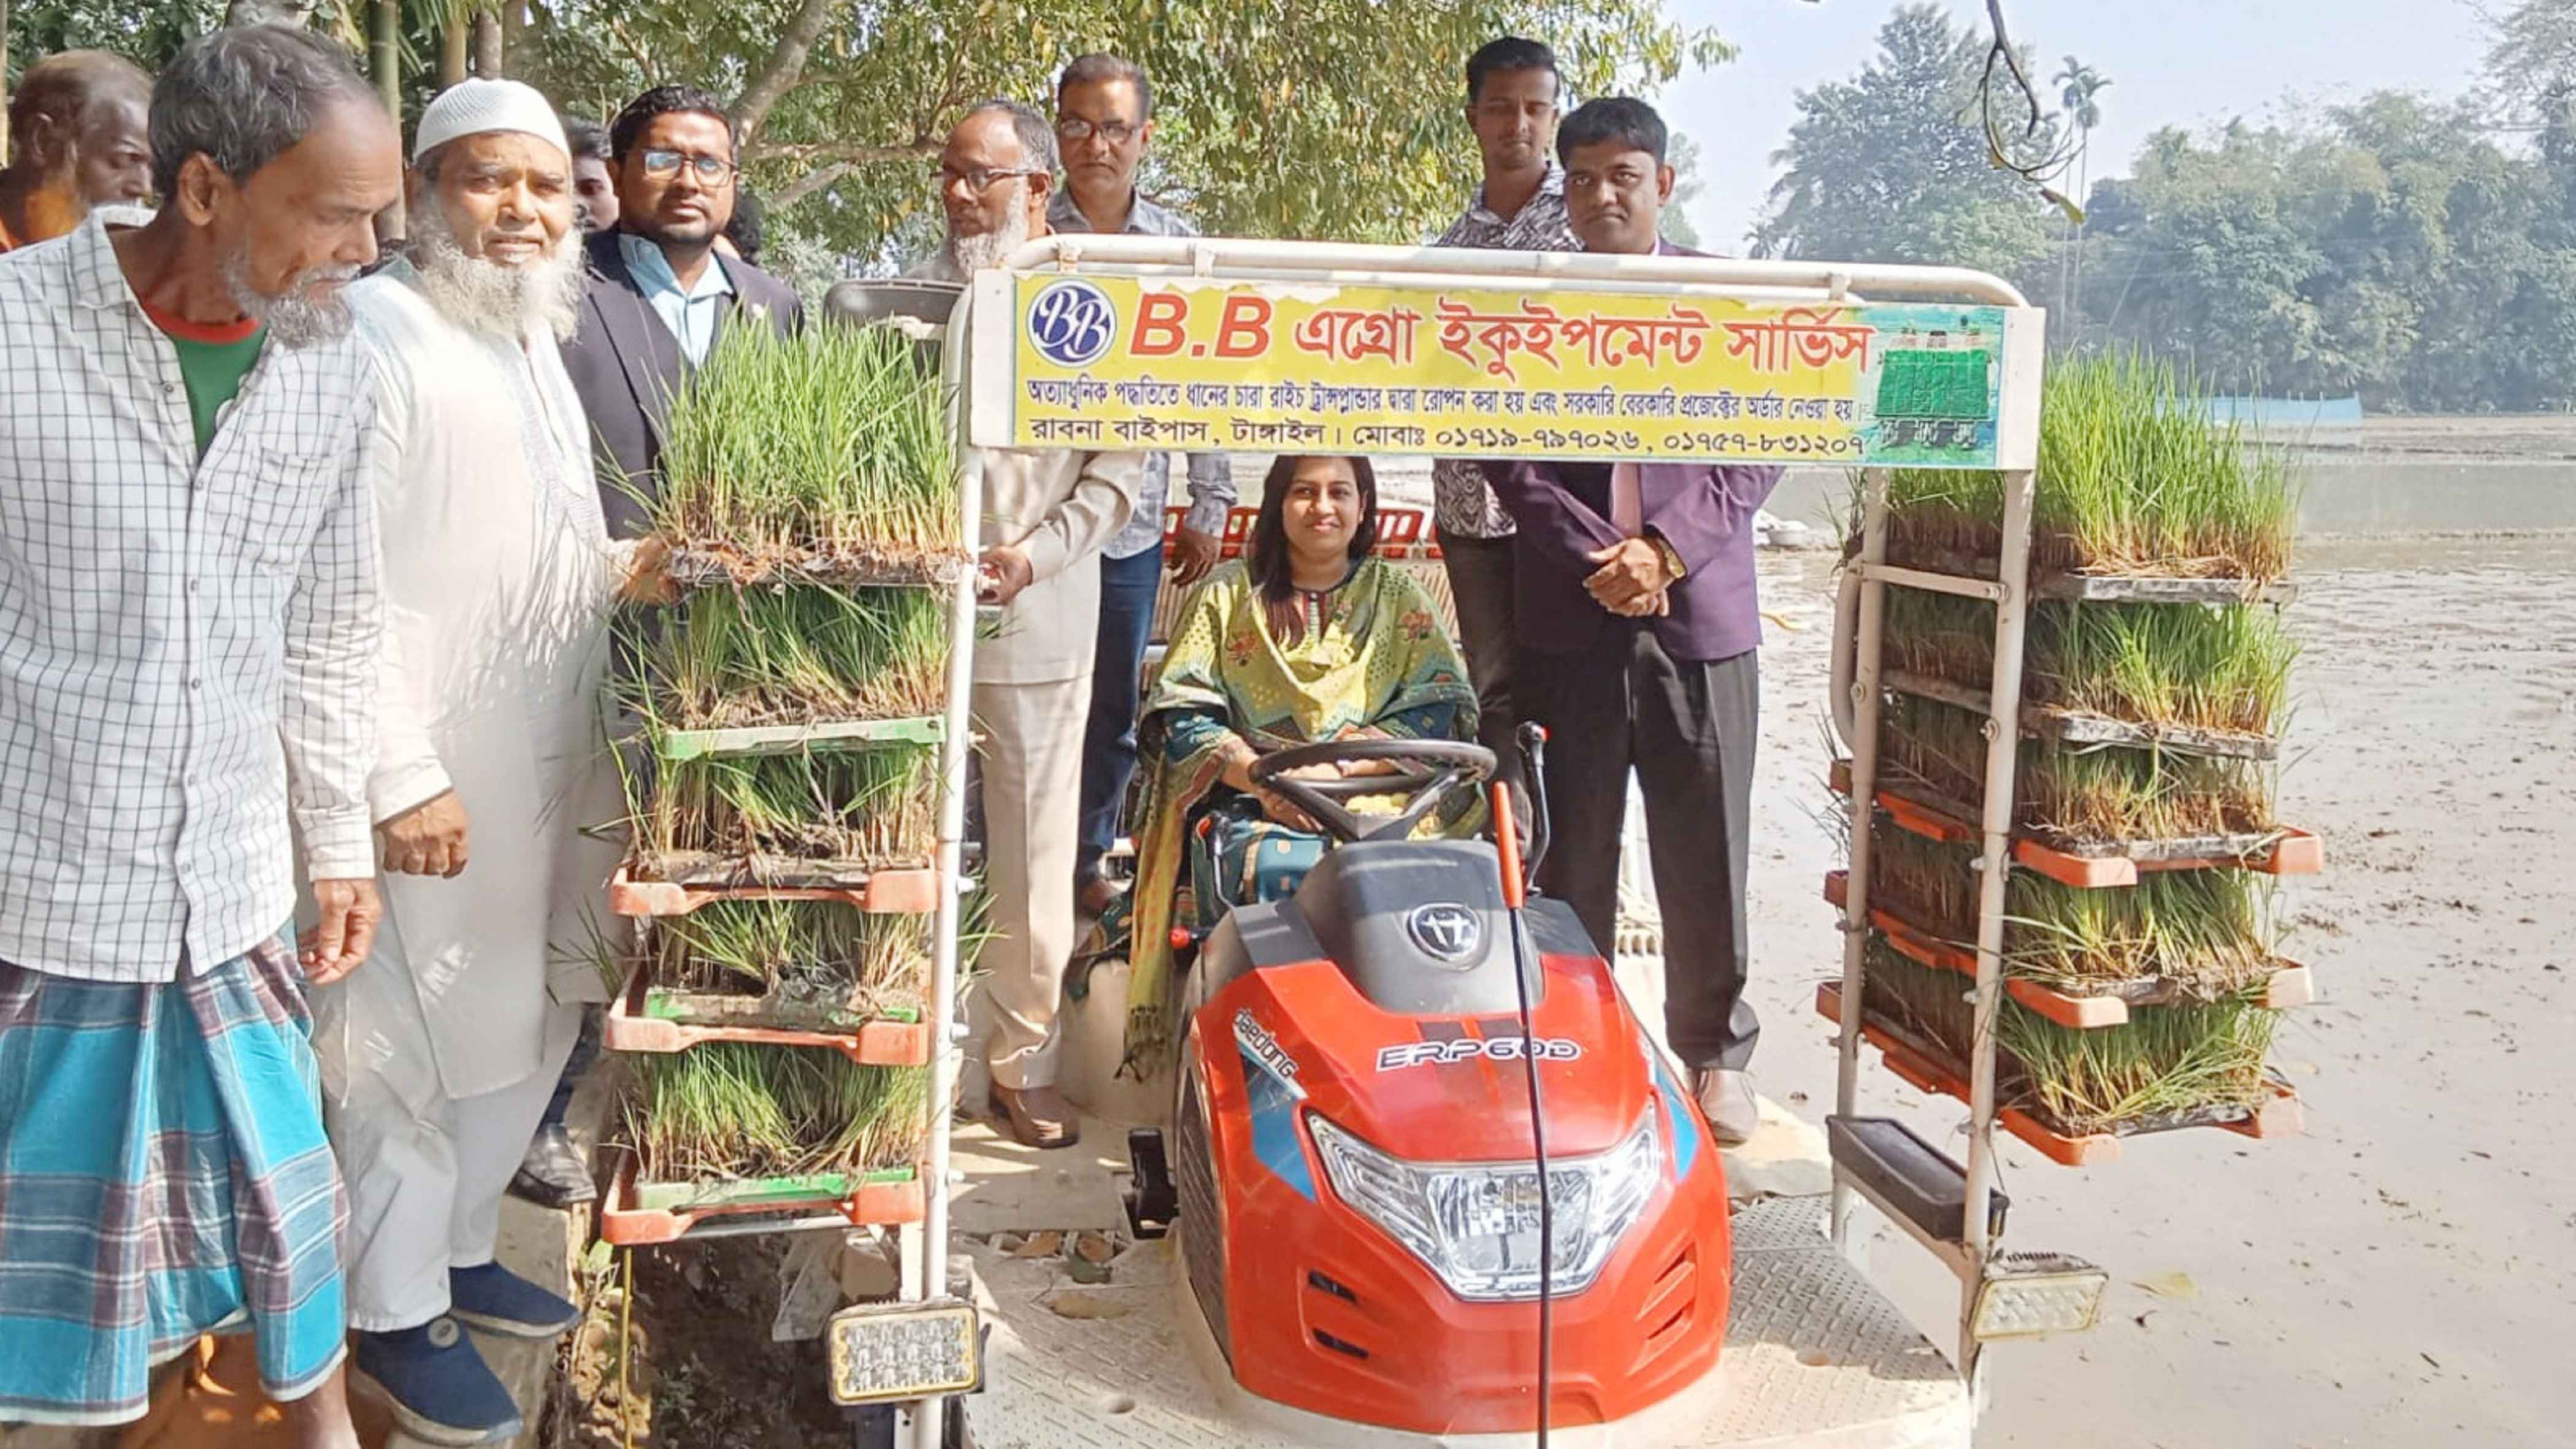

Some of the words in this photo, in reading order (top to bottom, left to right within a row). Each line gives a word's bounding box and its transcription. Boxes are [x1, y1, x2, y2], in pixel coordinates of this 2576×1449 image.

[1130, 292, 1271, 358] B.B
[1295, 305, 1422, 365] এগ্রো
[1435, 296, 1711, 383] ইকুইপমেন্ট
[1722, 305, 1877, 373] সার্ভিস
[1027, 372, 1109, 411] অত্যাধুনিক
[1114, 374, 1181, 407] পদ্ধতিতে
[1186, 381, 1229, 408] ধানের
[1233, 385, 1264, 409] চারা
[1421, 388, 1466, 414] রোপন
[1471, 390, 1499, 413] করা
[1503, 391, 1525, 416] হয়
[1530, 391, 1558, 416] এবং
[1563, 385, 1616, 417] সরকারি
[1746, 389, 1785, 420] অর্ডার
[1029, 418, 1103, 441] রাবনা
[1663, 432, 1863, 455] ০১৭৫৭-৮৩১২০৭
